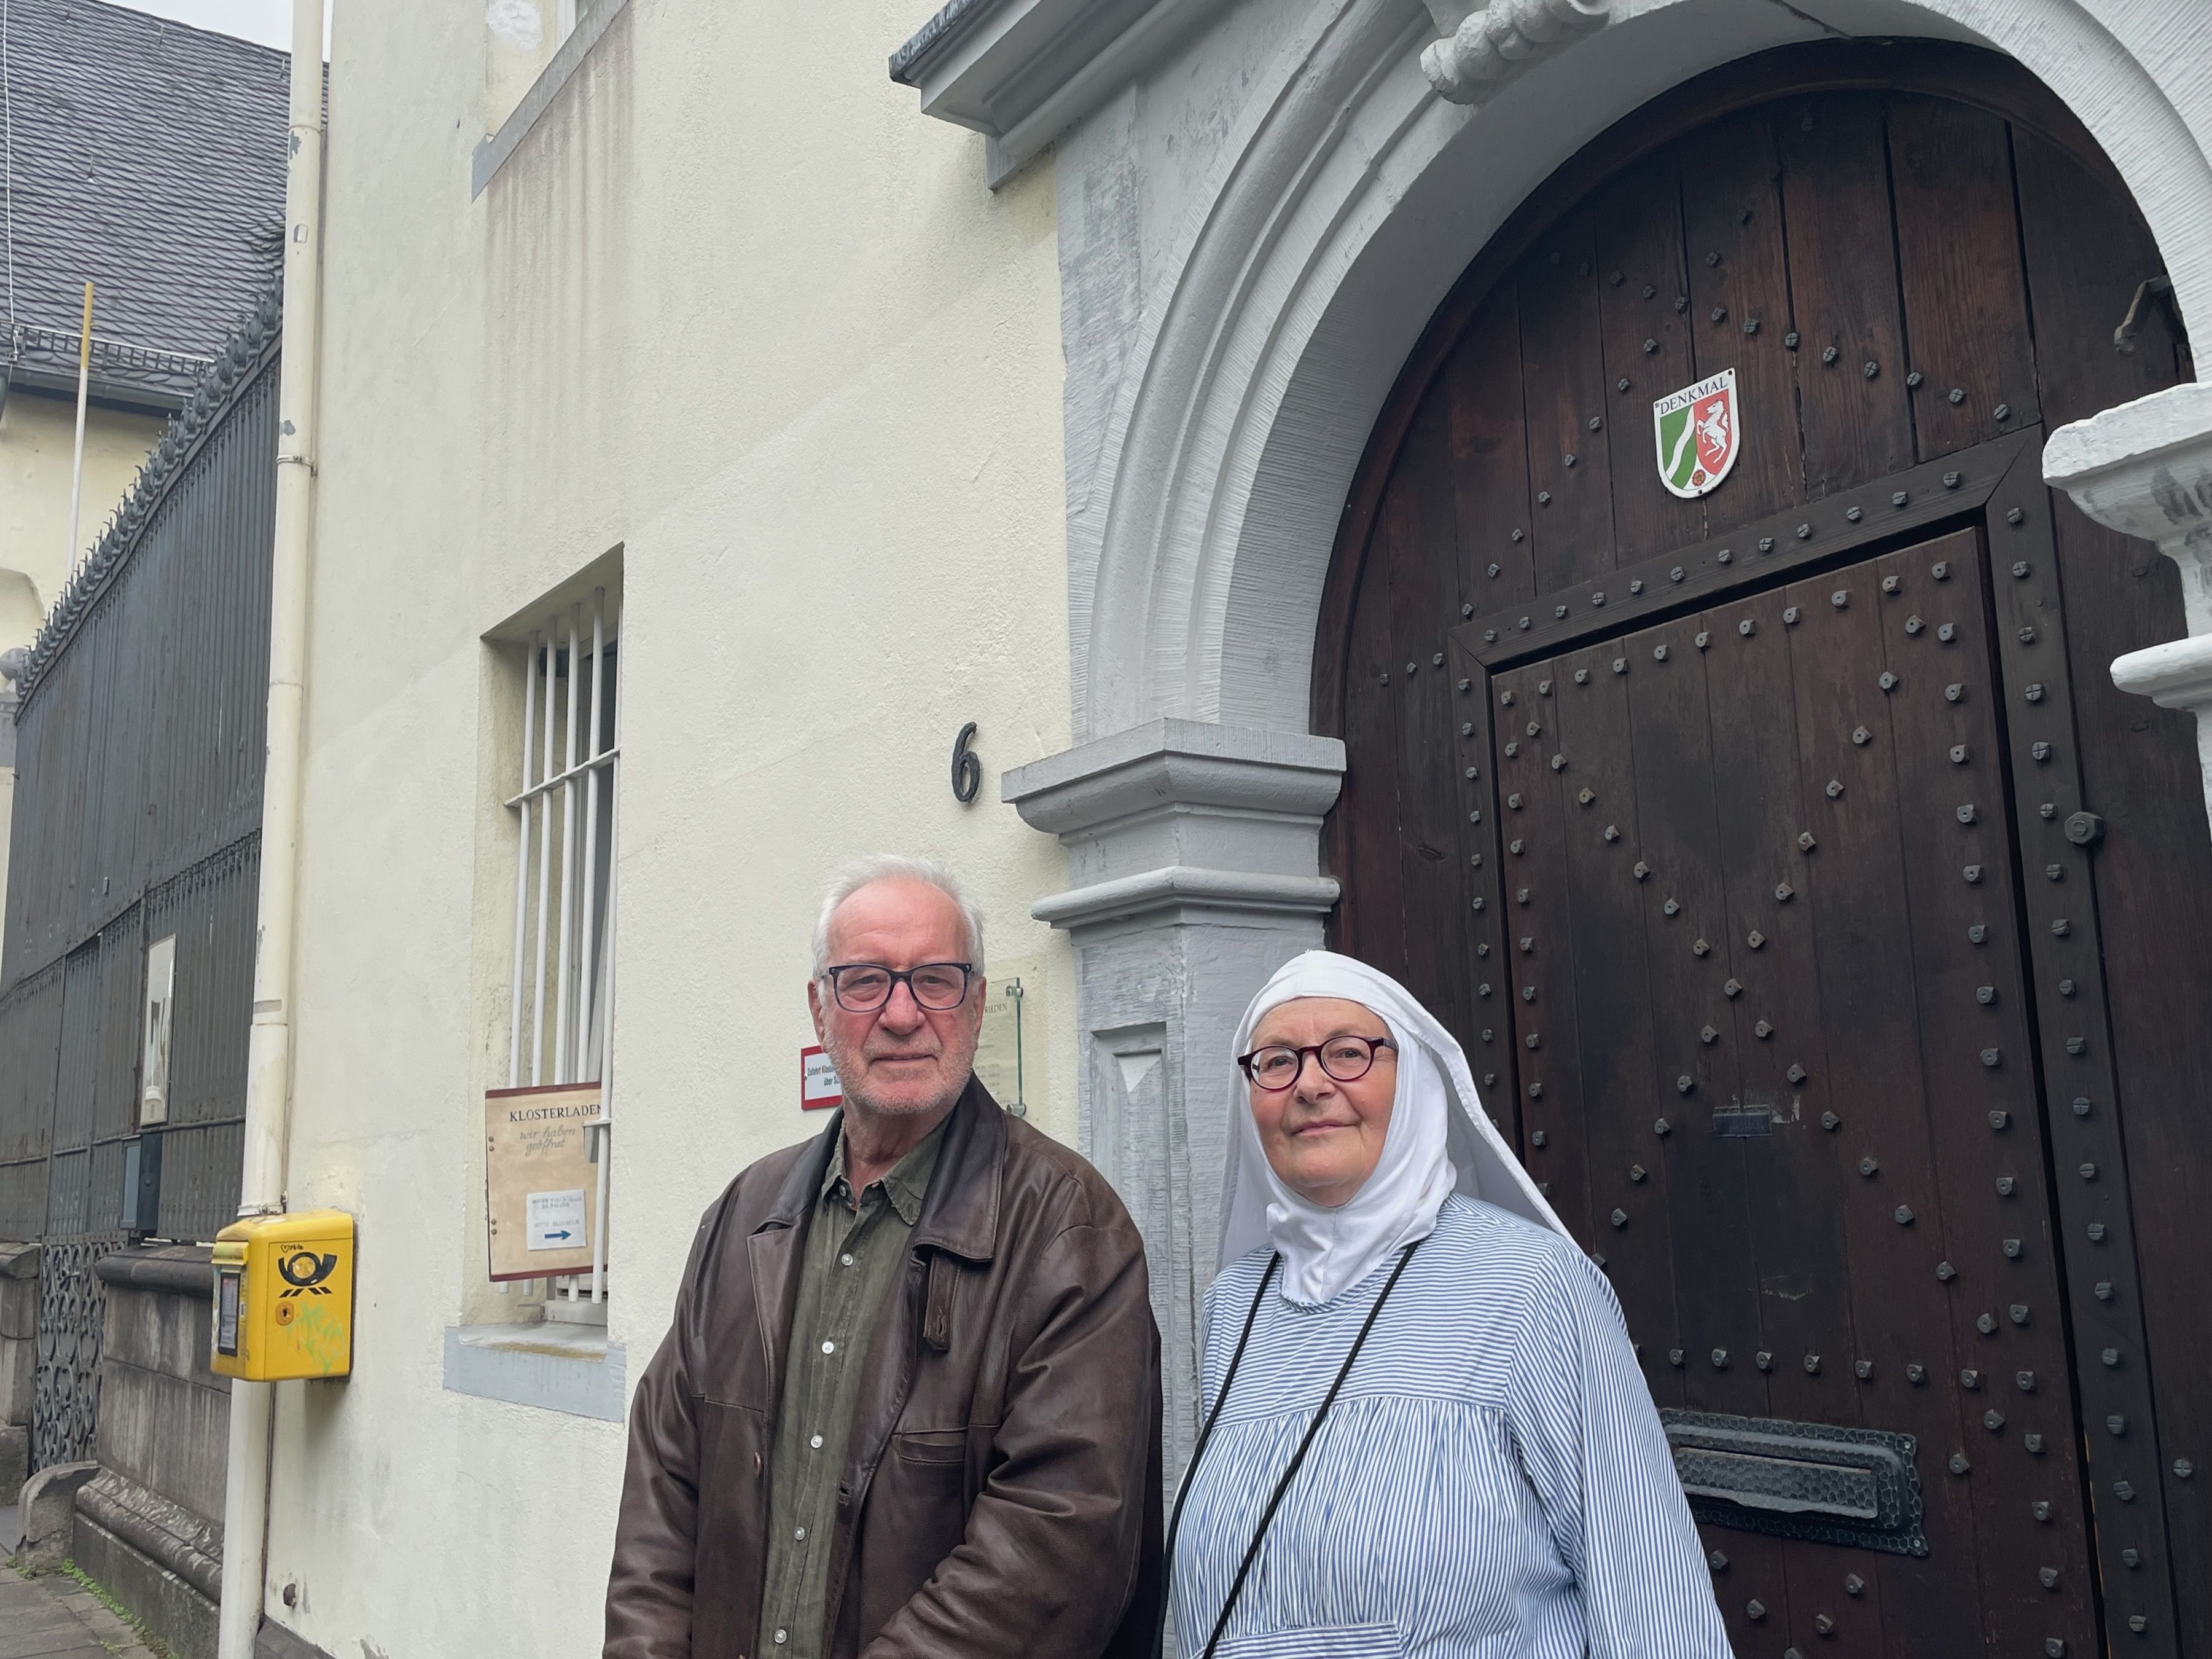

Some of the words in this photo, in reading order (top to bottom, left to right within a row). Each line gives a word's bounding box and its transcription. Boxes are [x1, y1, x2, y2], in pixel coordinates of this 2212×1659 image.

[1660, 376, 1728, 415] DENKMAL
[952, 721, 980, 802] 6
[984, 1003, 1007, 1014] RIEDEN
[520, 1129, 539, 1140] wir
[543, 1124, 576, 1139] haben
[525, 1137, 566, 1156] geöffnet
